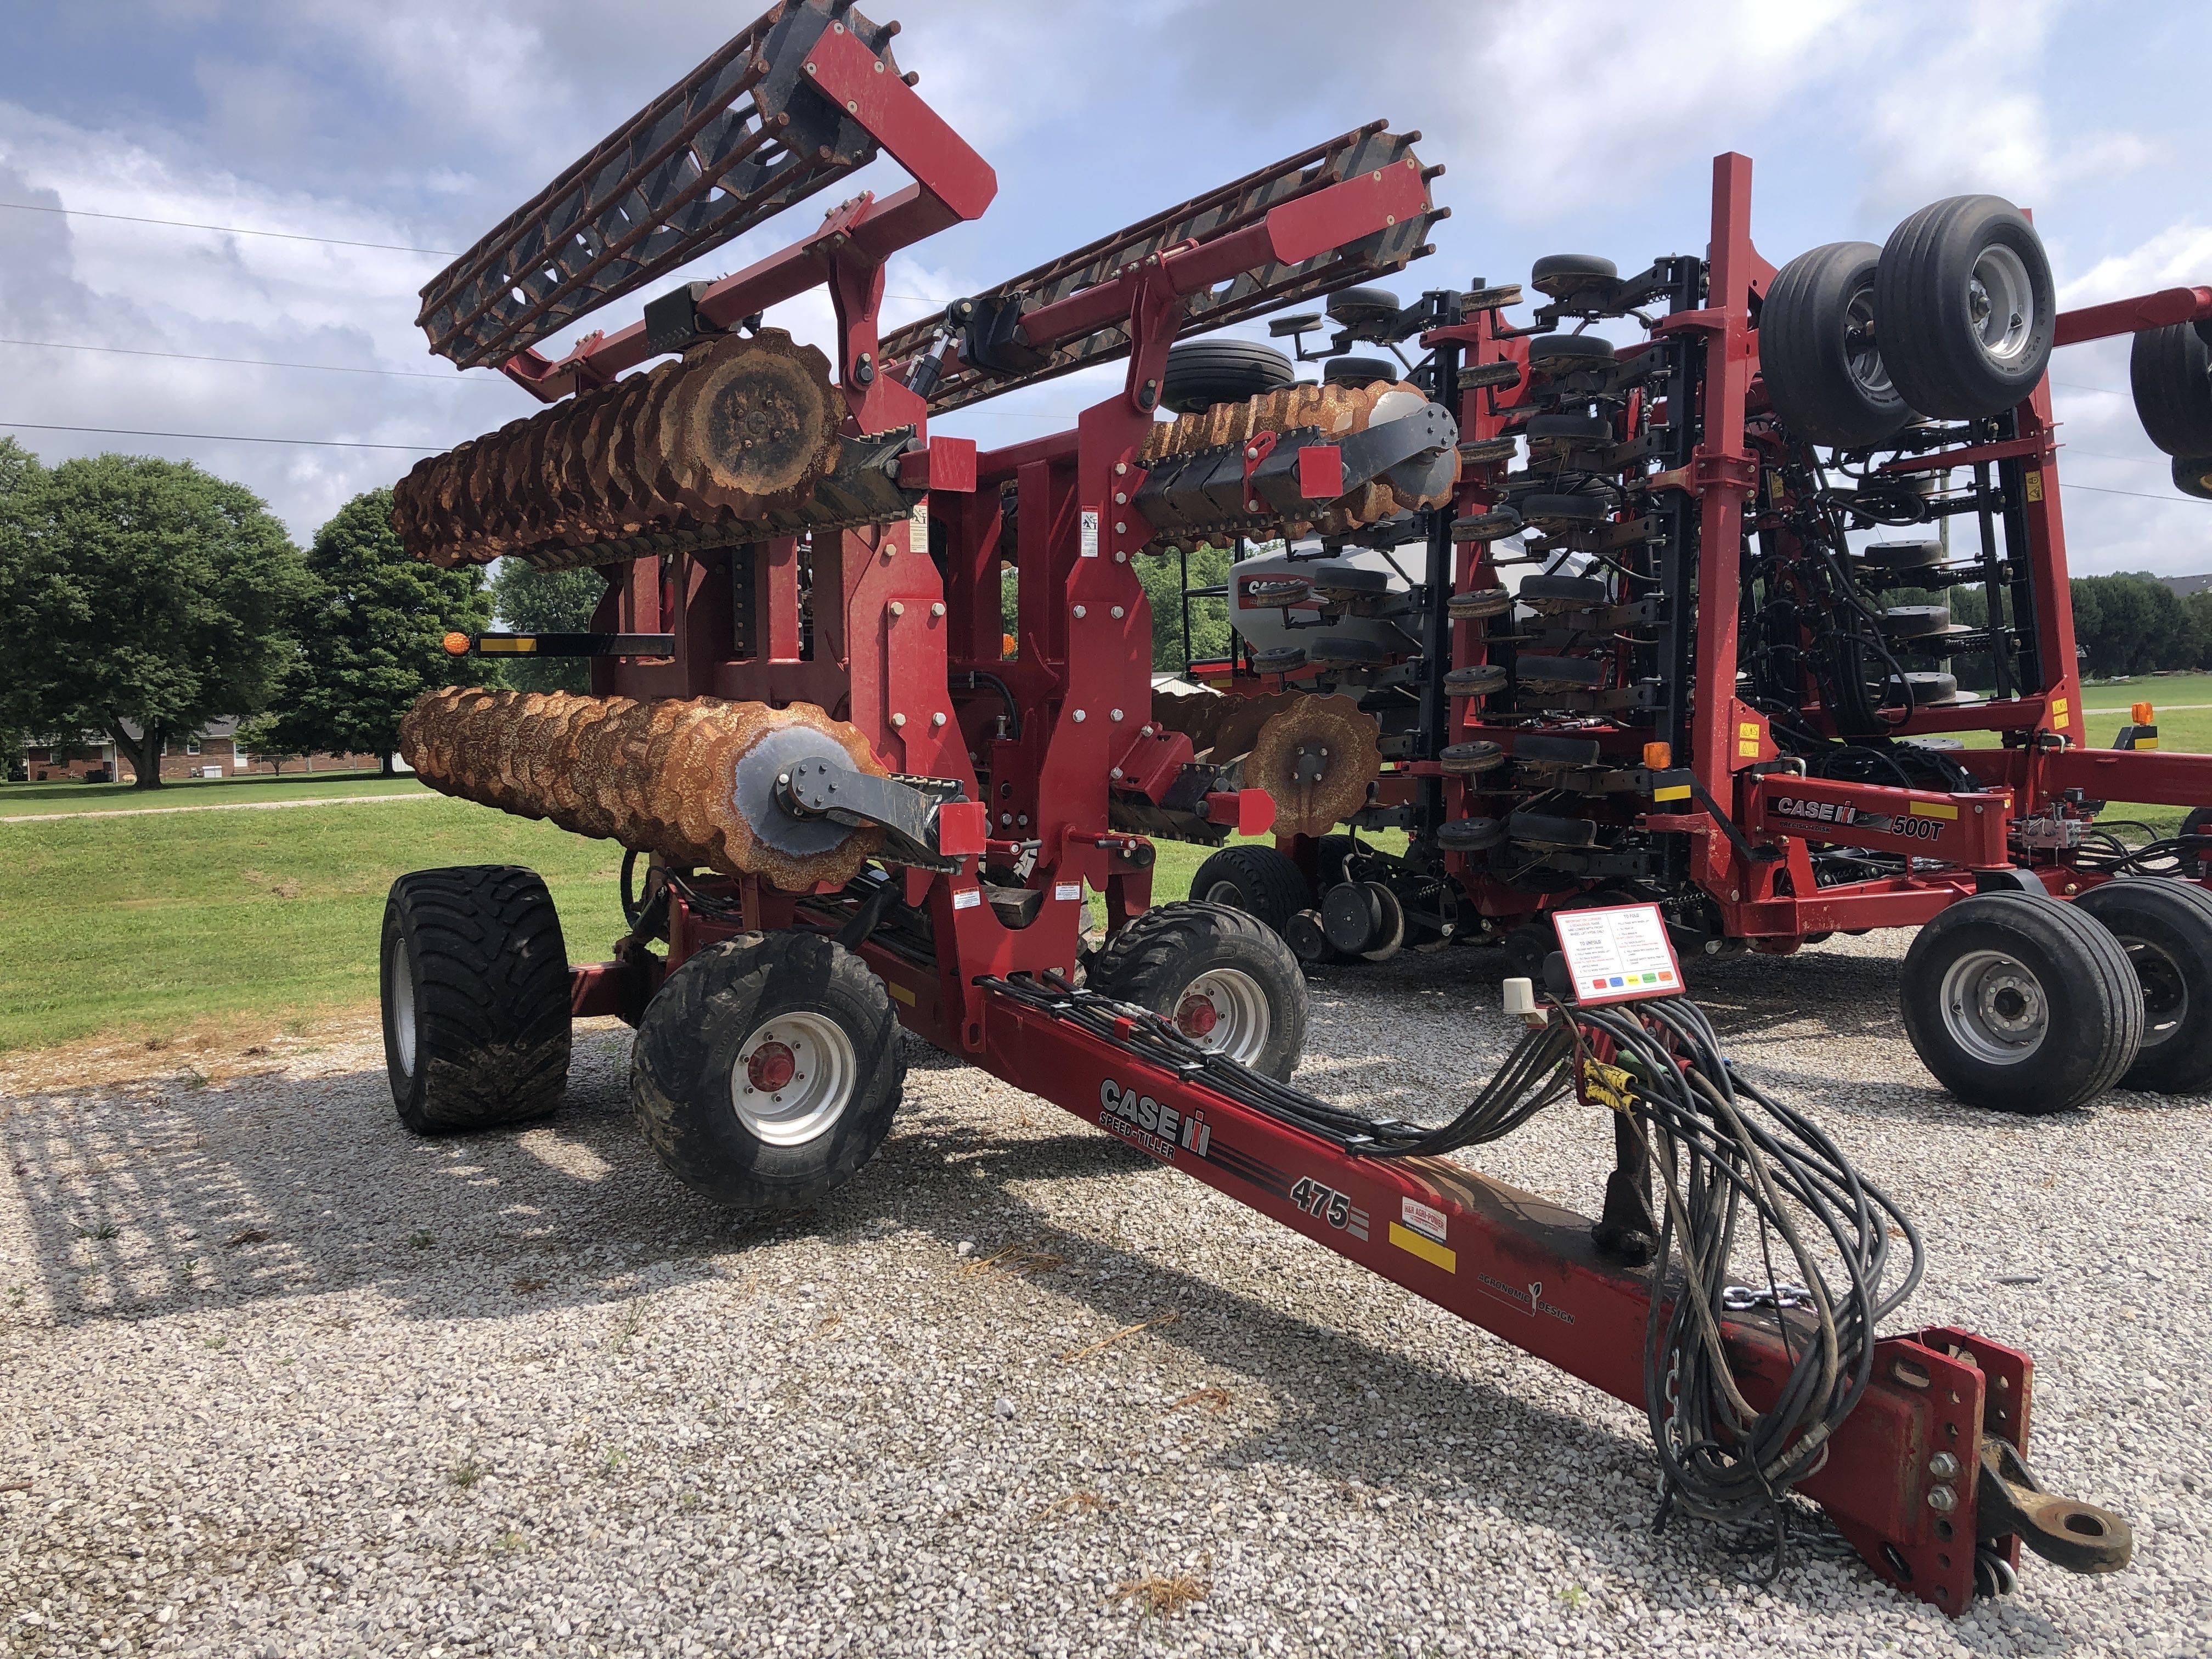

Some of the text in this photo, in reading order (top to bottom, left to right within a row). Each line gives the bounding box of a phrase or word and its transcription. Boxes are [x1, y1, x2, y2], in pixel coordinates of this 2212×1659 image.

[1779, 798, 1833, 821] CASE
[1892, 815, 1945, 841] 500T
[1779, 821, 1814, 831] PRECISION
[1101, 1079, 1180, 1141] CASE
[1100, 1111, 1175, 1160] SPEED-TILLER
[1290, 1176, 1351, 1229] 475
[1415, 1207, 1444, 1230] AGRI-POWER
[1477, 1273, 1576, 1325] AGRONOMIC DESIGN
